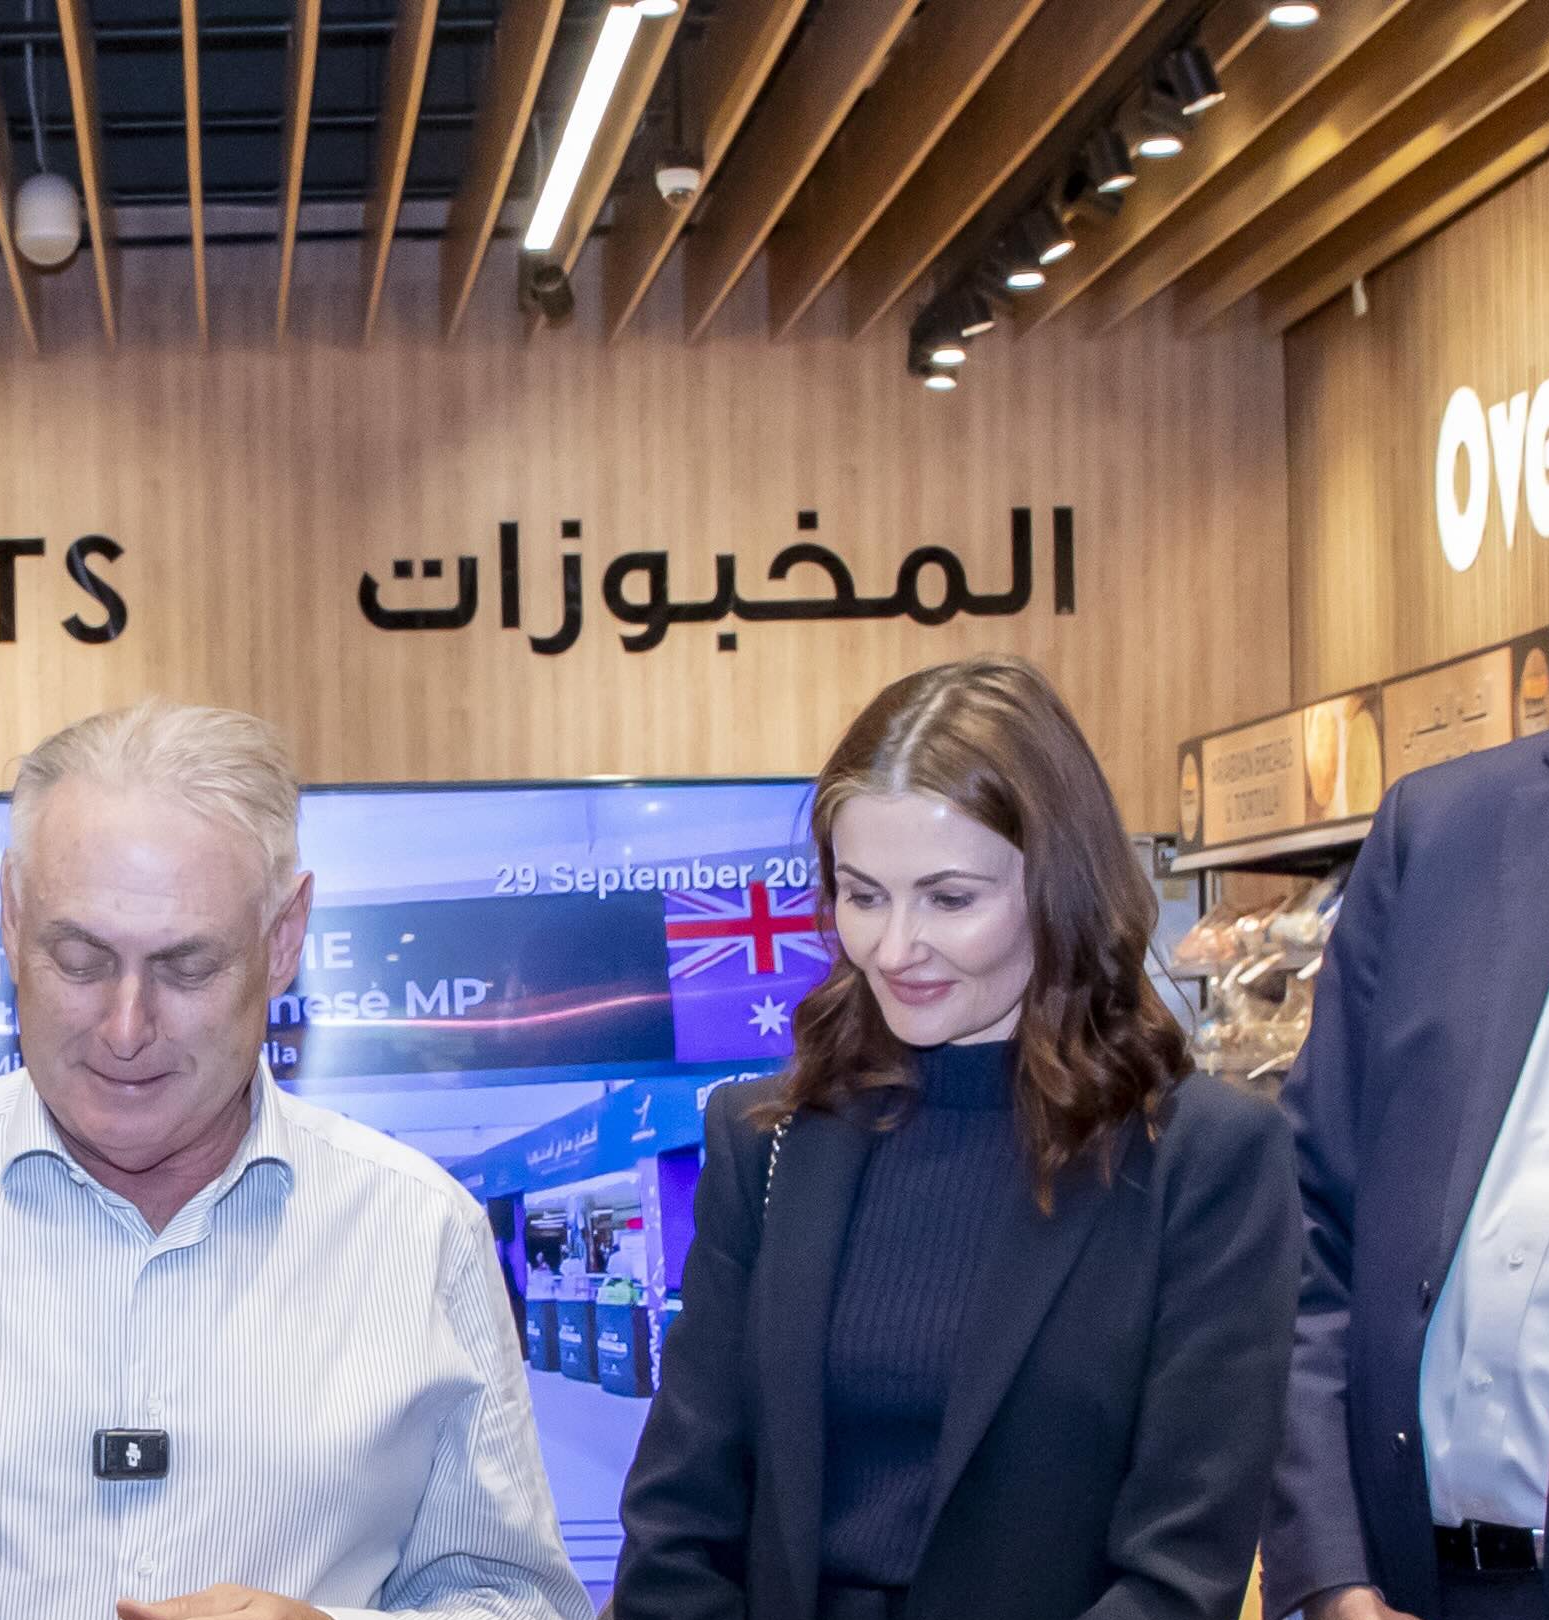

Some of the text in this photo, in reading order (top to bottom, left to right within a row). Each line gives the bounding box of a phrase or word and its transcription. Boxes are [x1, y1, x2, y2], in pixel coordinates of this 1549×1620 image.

[358, 505, 1076, 656] المخبوزات
[494, 863, 538, 894] 29
[550, 857, 754, 901] September
[406, 977, 487, 1018] MP
